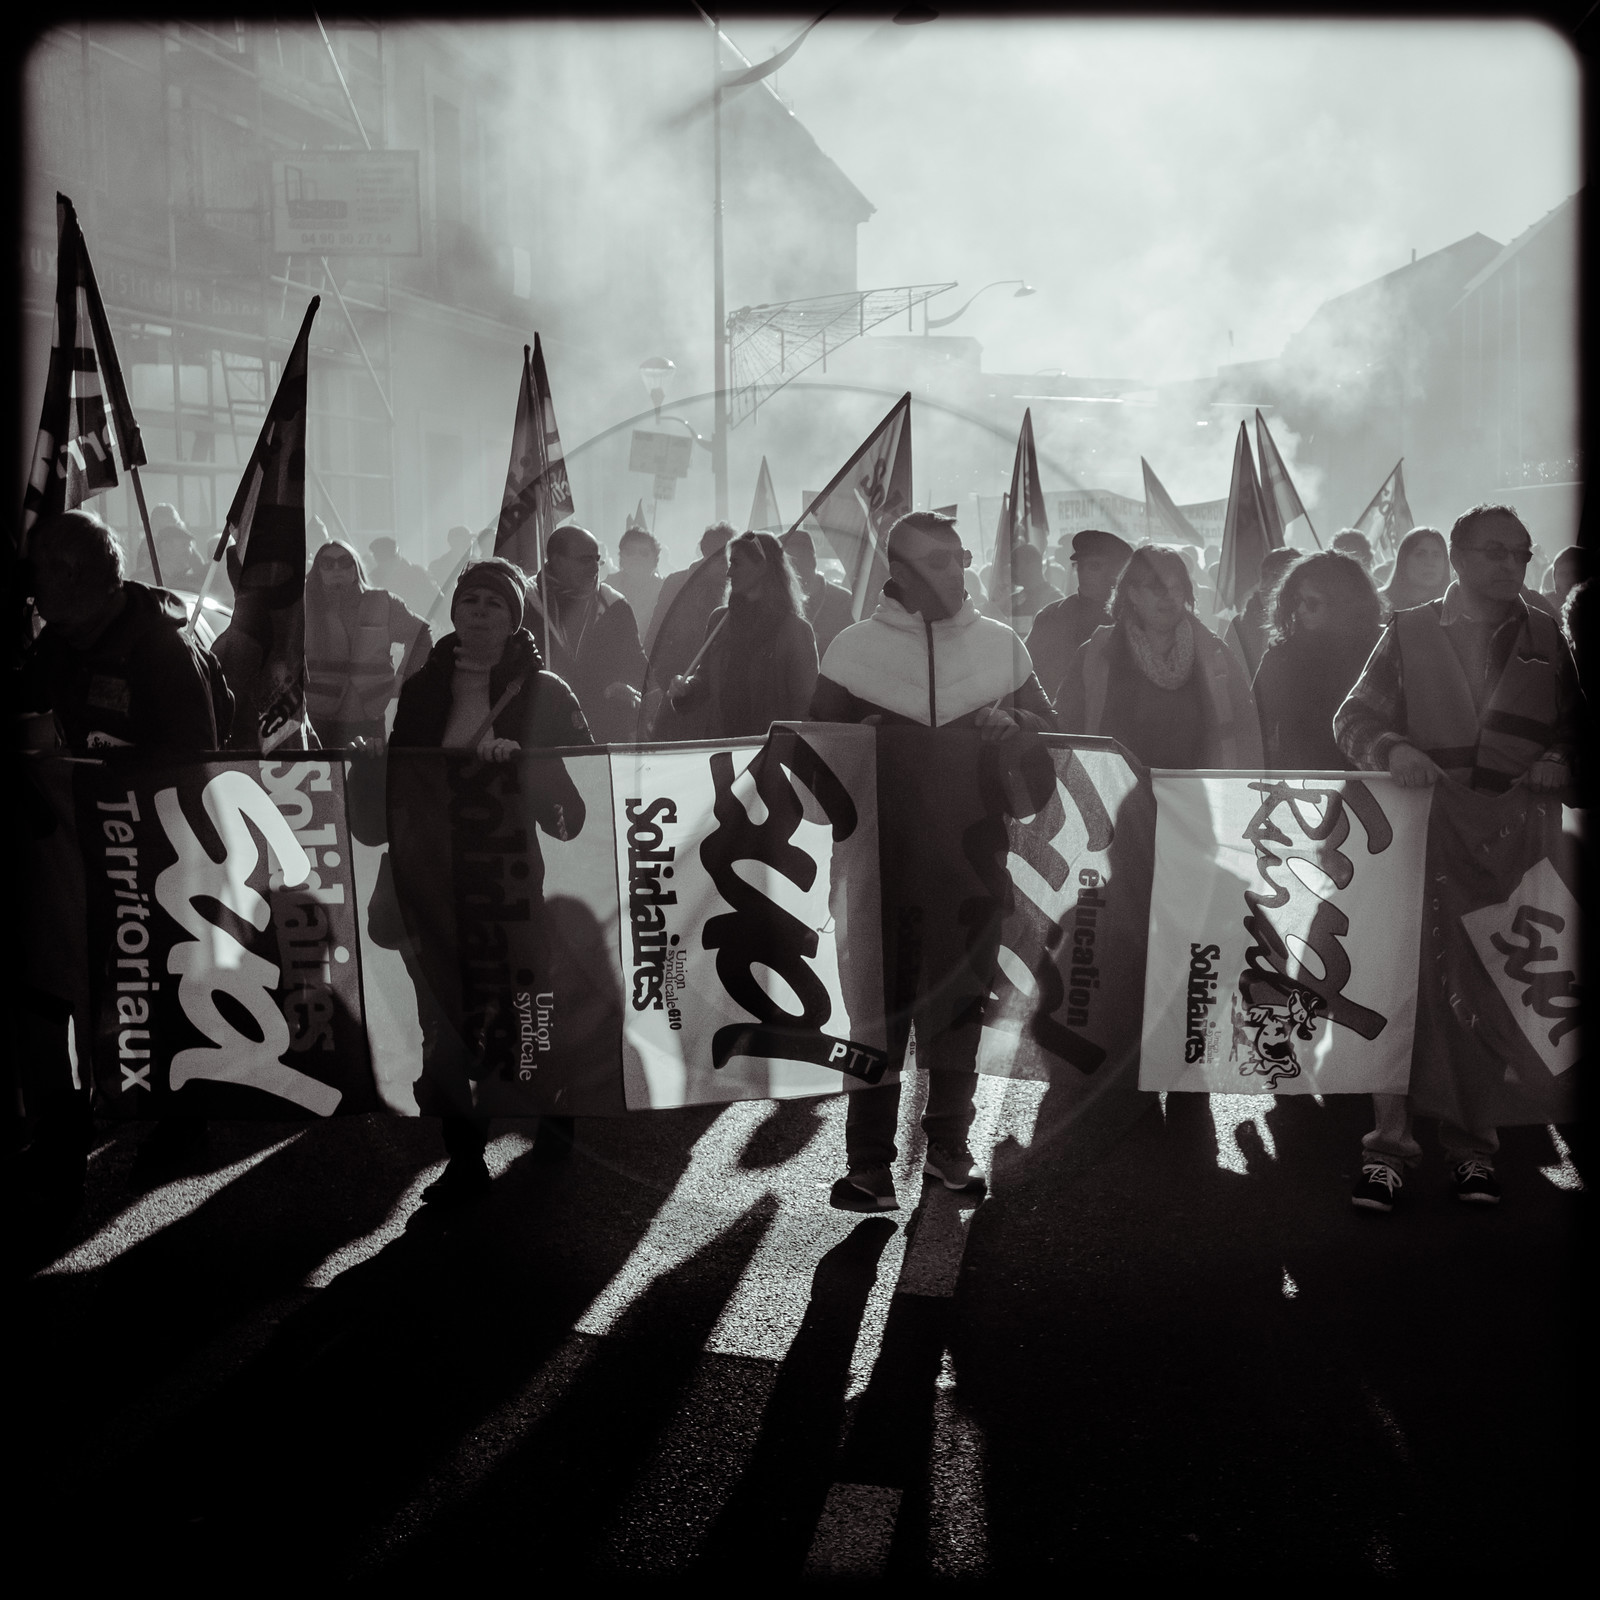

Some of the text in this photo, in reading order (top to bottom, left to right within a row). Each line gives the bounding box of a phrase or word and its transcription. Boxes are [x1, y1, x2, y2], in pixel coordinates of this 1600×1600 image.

[301, 232, 316, 245] 04
[96, 790, 160, 1093] Territoriaux
[625, 797, 680, 1012] Solidaires
[665, 949, 678, 1009] syndicale
[676, 949, 688, 990] Union
[1066, 868, 1108, 1028] éducation
[513, 991, 538, 1082] syndicale
[535, 991, 554, 1052] Union
[1185, 942, 1221, 1064] Solidaires
[828, 1041, 880, 1076] PTT
